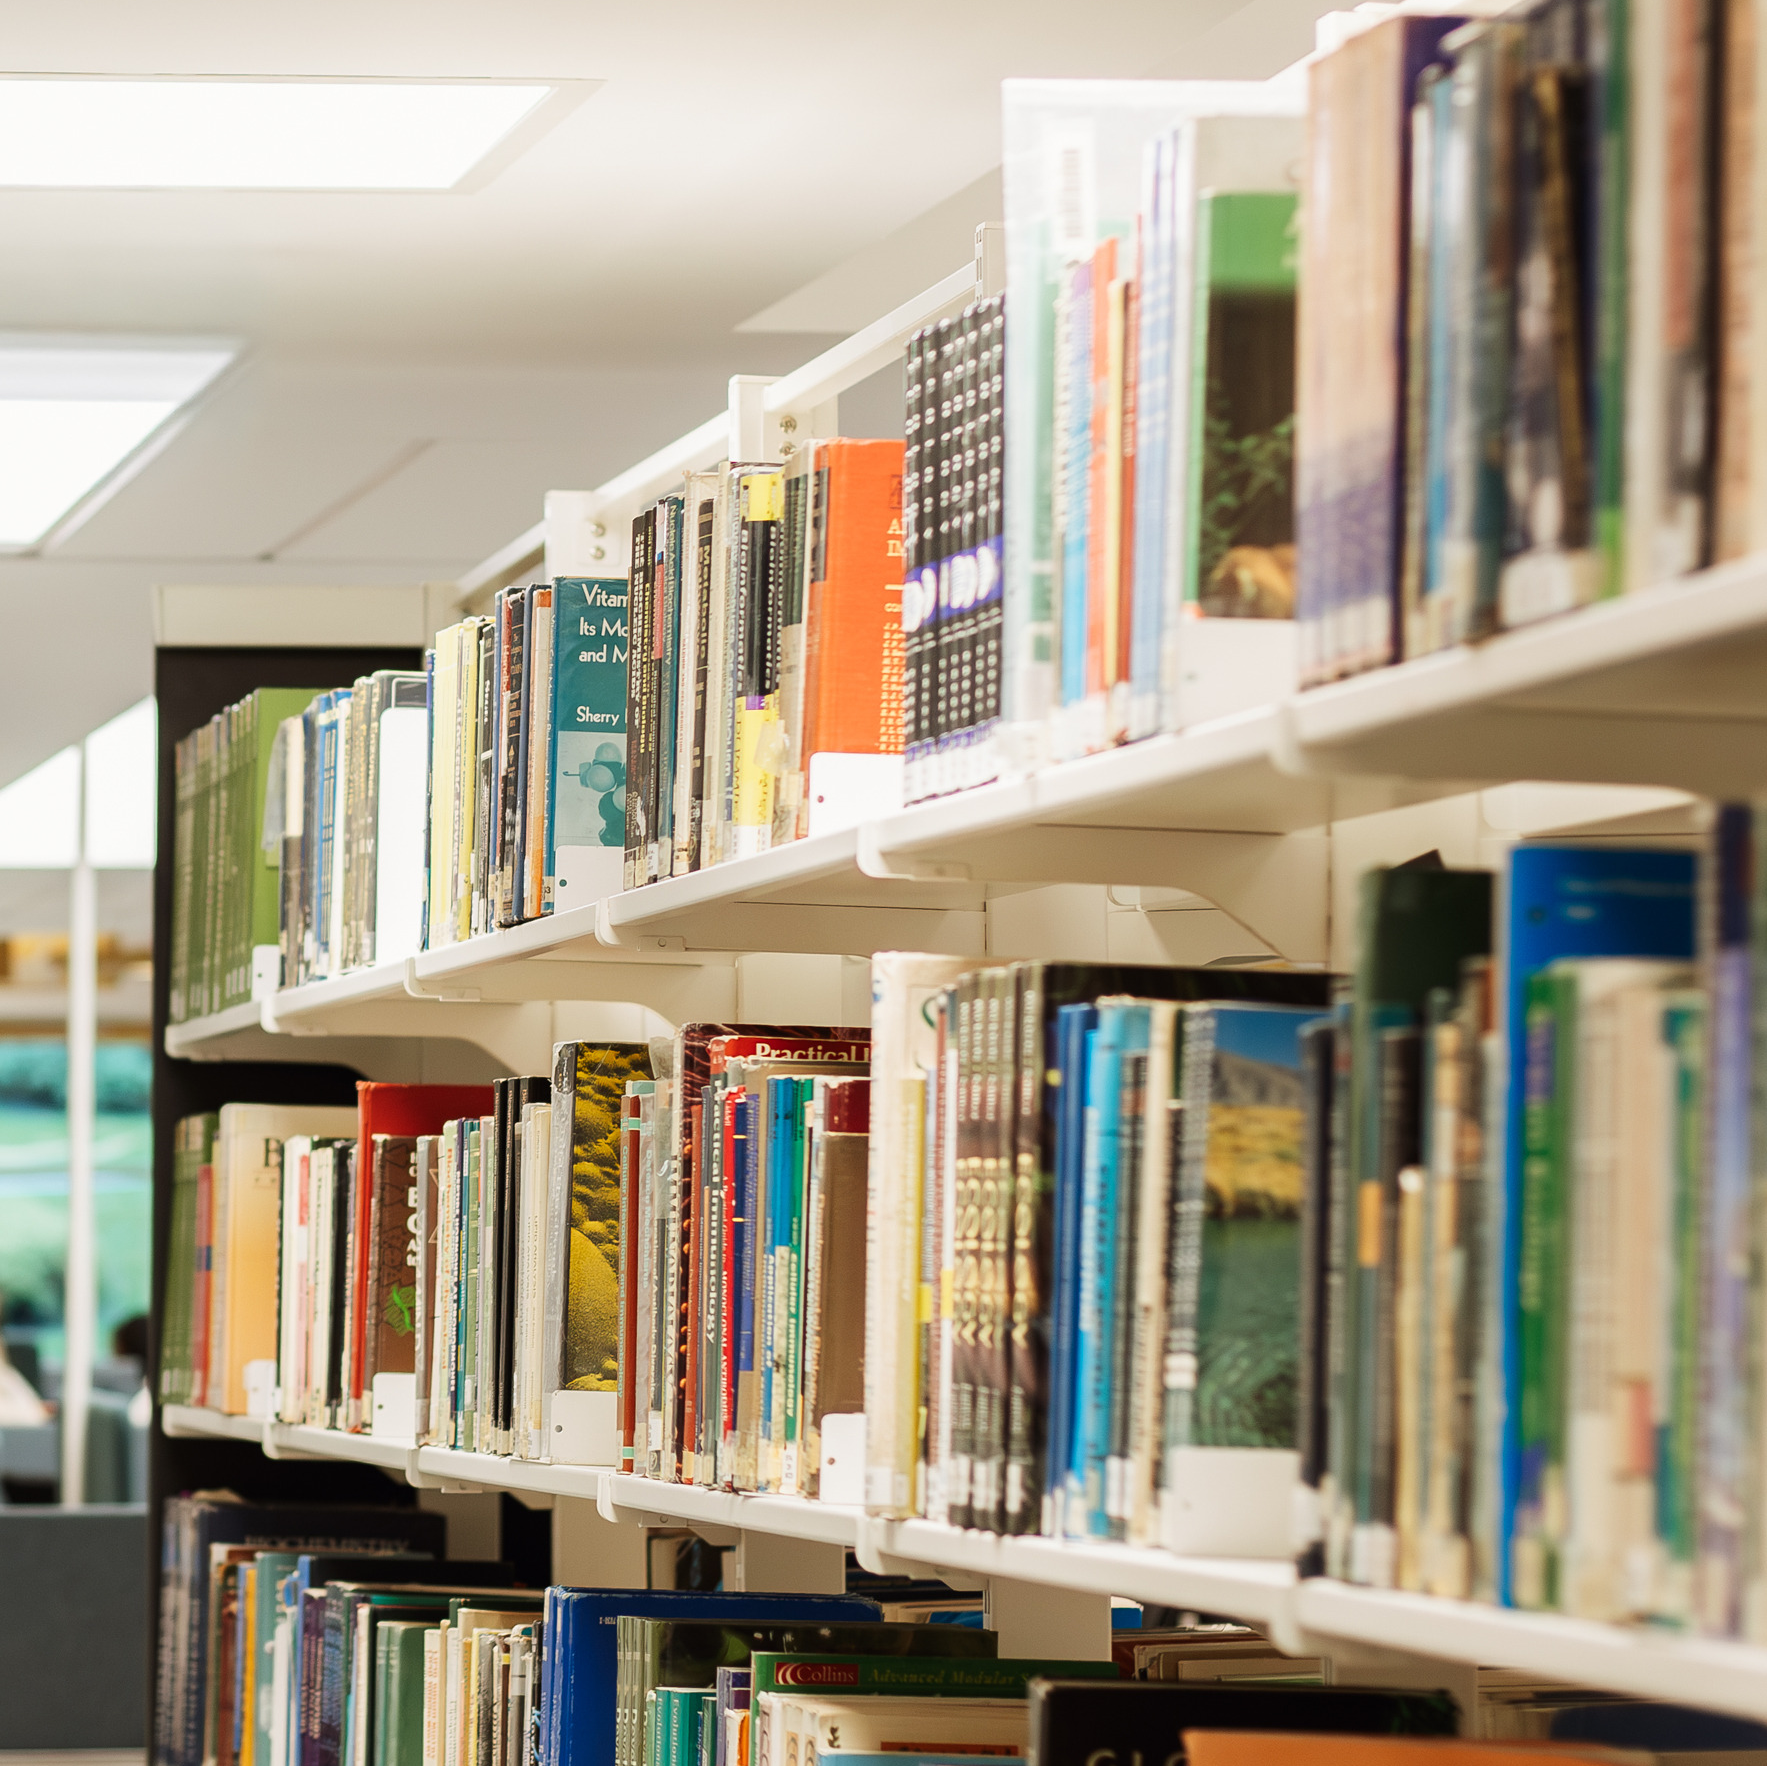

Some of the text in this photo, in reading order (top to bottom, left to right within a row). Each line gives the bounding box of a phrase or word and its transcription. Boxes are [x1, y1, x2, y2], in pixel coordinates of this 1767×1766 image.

[579, 618, 597, 636] Its
[632, 573, 640, 645] NUCLEIC
[635, 571, 644, 703] BIOCHEMISTRY
[642, 583, 650, 662] Chemistry
[665, 581, 675, 665] Biochemistry
[700, 545, 711, 659] Metabolic
[736, 529, 749, 693] Bioinformatics
[764, 525, 777, 690] Bioinformatics
[579, 644, 607, 664] and
[576, 706, 619, 727] Sherry
[756, 1043, 856, 1062] Practical
[443, 1148, 453, 1255] Biochemistry
[706, 1079, 722, 1344] Practical Immunology
[643, 1206, 651, 1289] Mechanisms
[441, 1281, 451, 1370] cholesterol
[796, 1666, 855, 1683] Collins
